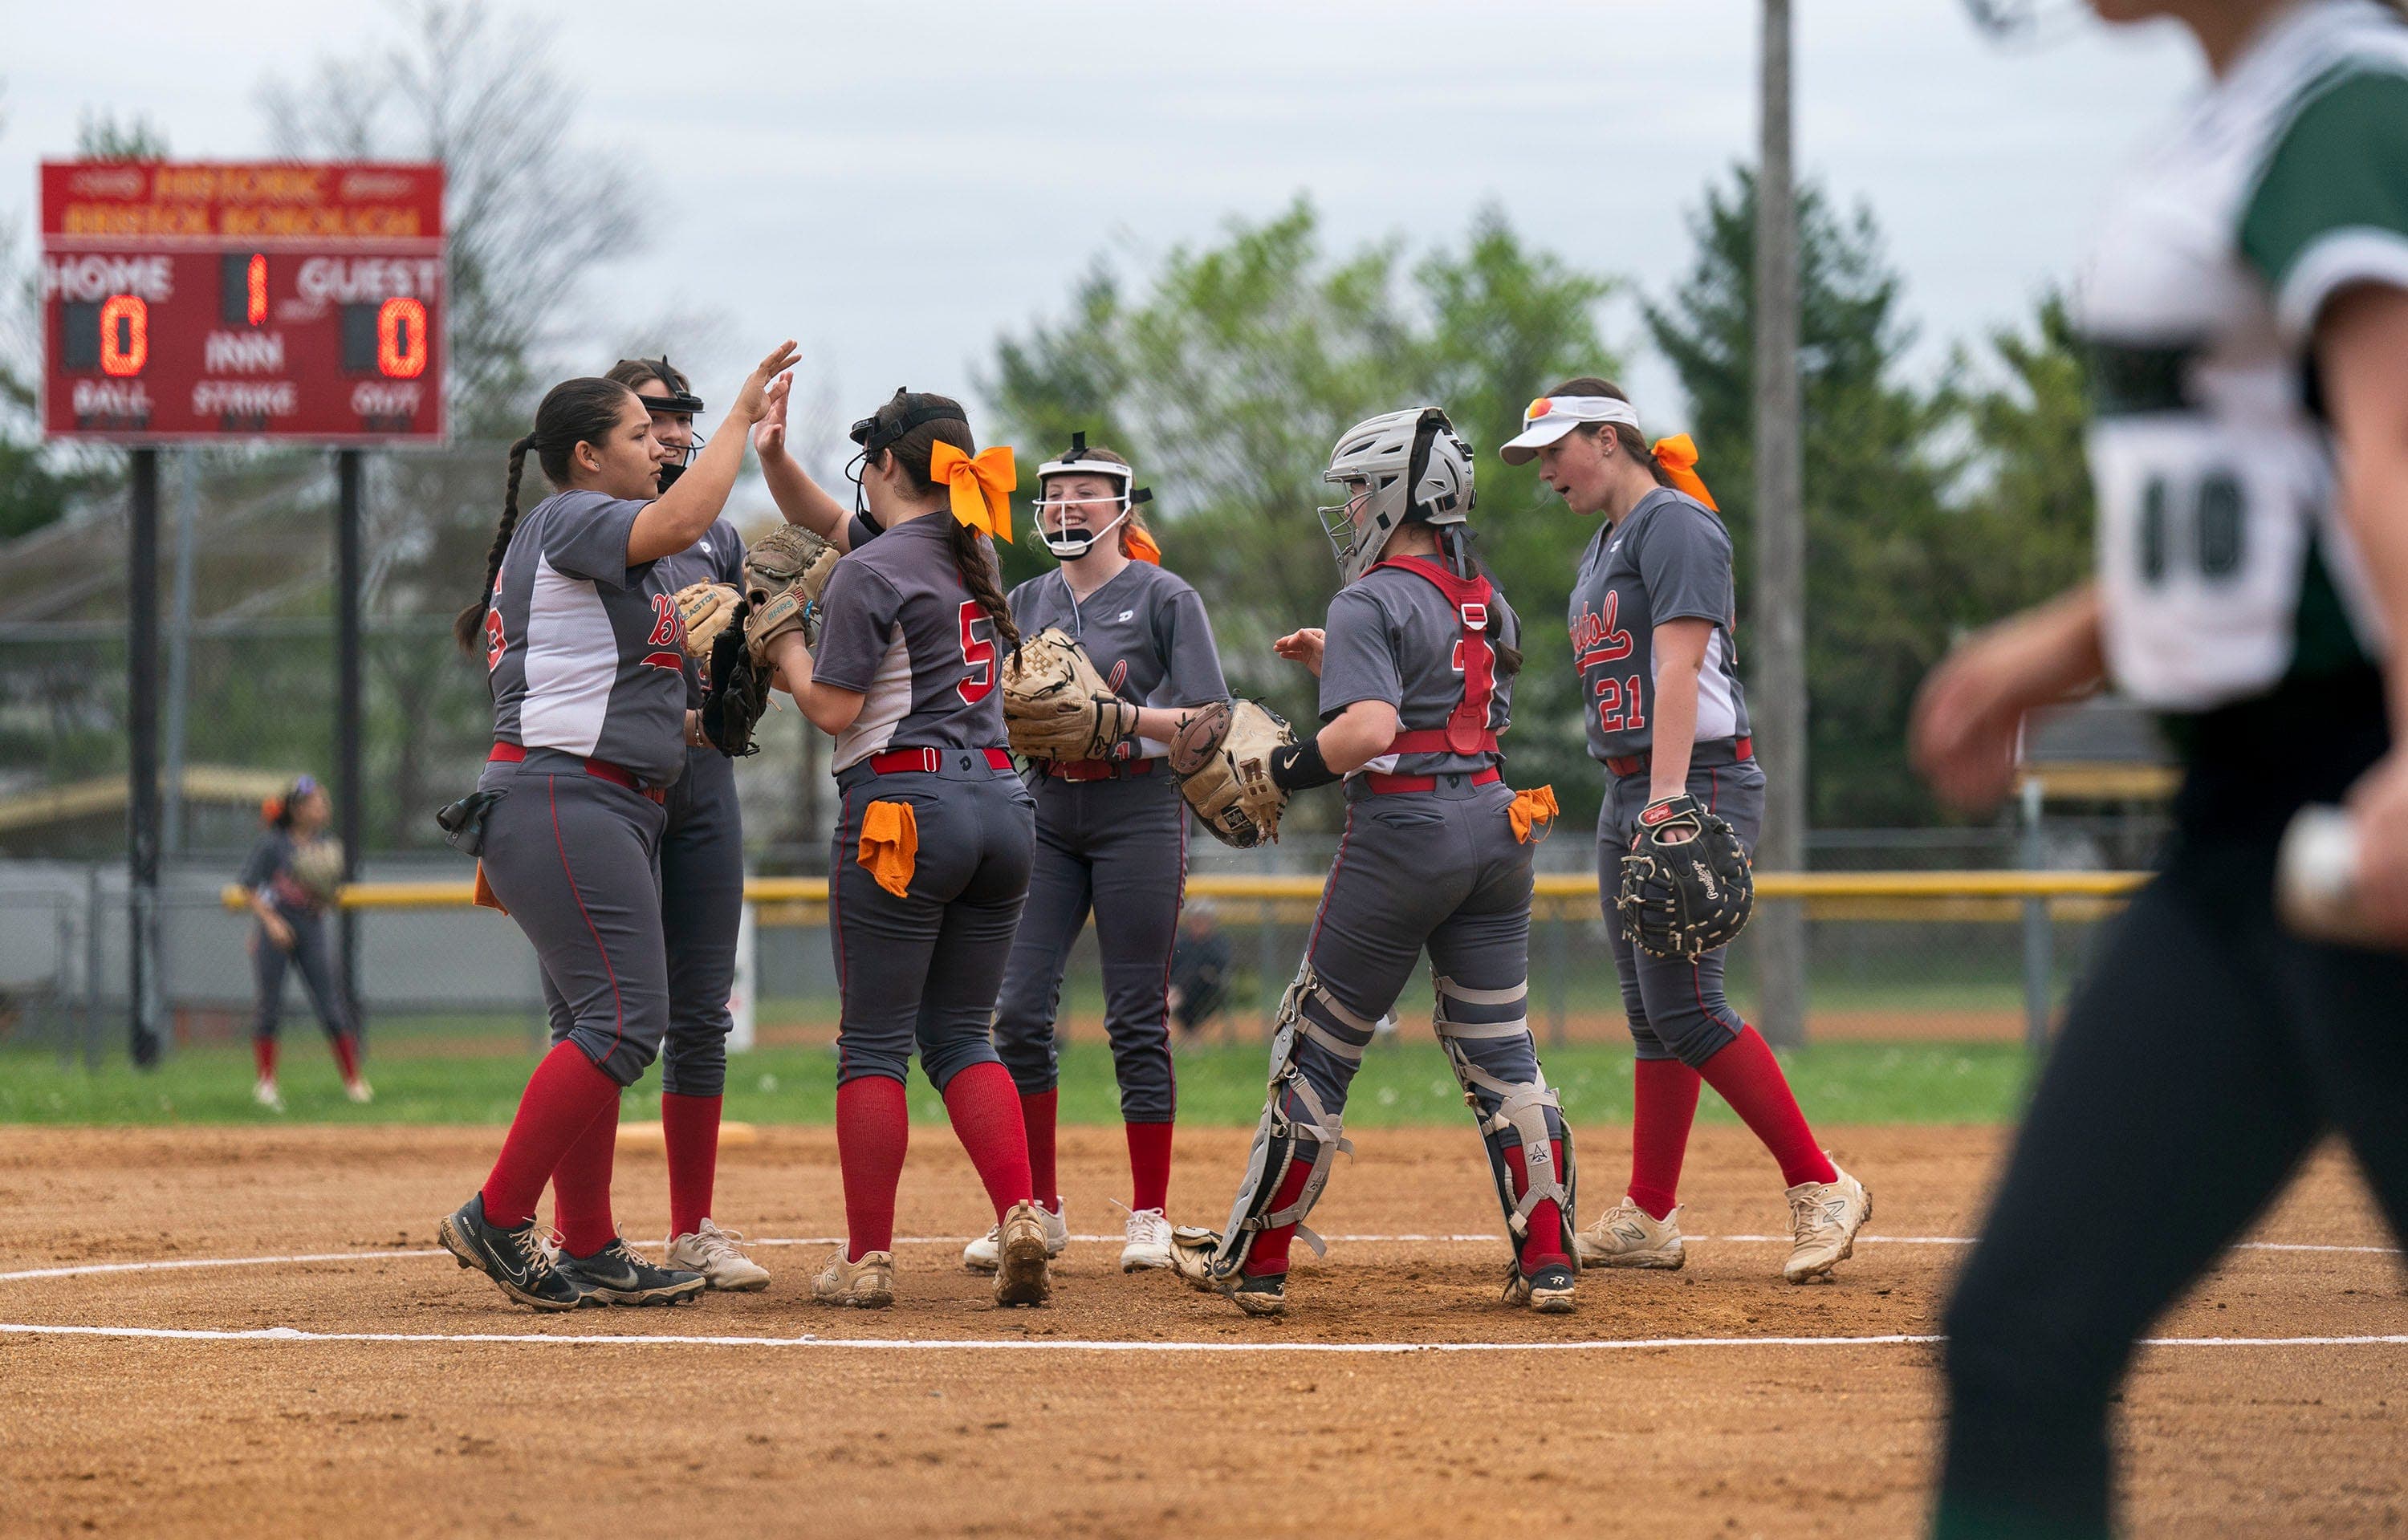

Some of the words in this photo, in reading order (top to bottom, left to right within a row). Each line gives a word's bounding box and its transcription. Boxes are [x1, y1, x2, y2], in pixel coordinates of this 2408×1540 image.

[41, 255, 172, 301] HOME
[247, 254, 267, 326] 1
[296, 258, 440, 301] GUEST
[100, 295, 148, 376] 0
[205, 331, 283, 372] INN
[378, 297, 427, 378] 0
[73, 380, 150, 415] BALL
[193, 380, 296, 415] STRIKE
[683, 591, 718, 621] EASTON
[956, 599, 996, 706] 5
[1596, 674, 1645, 733] 21
